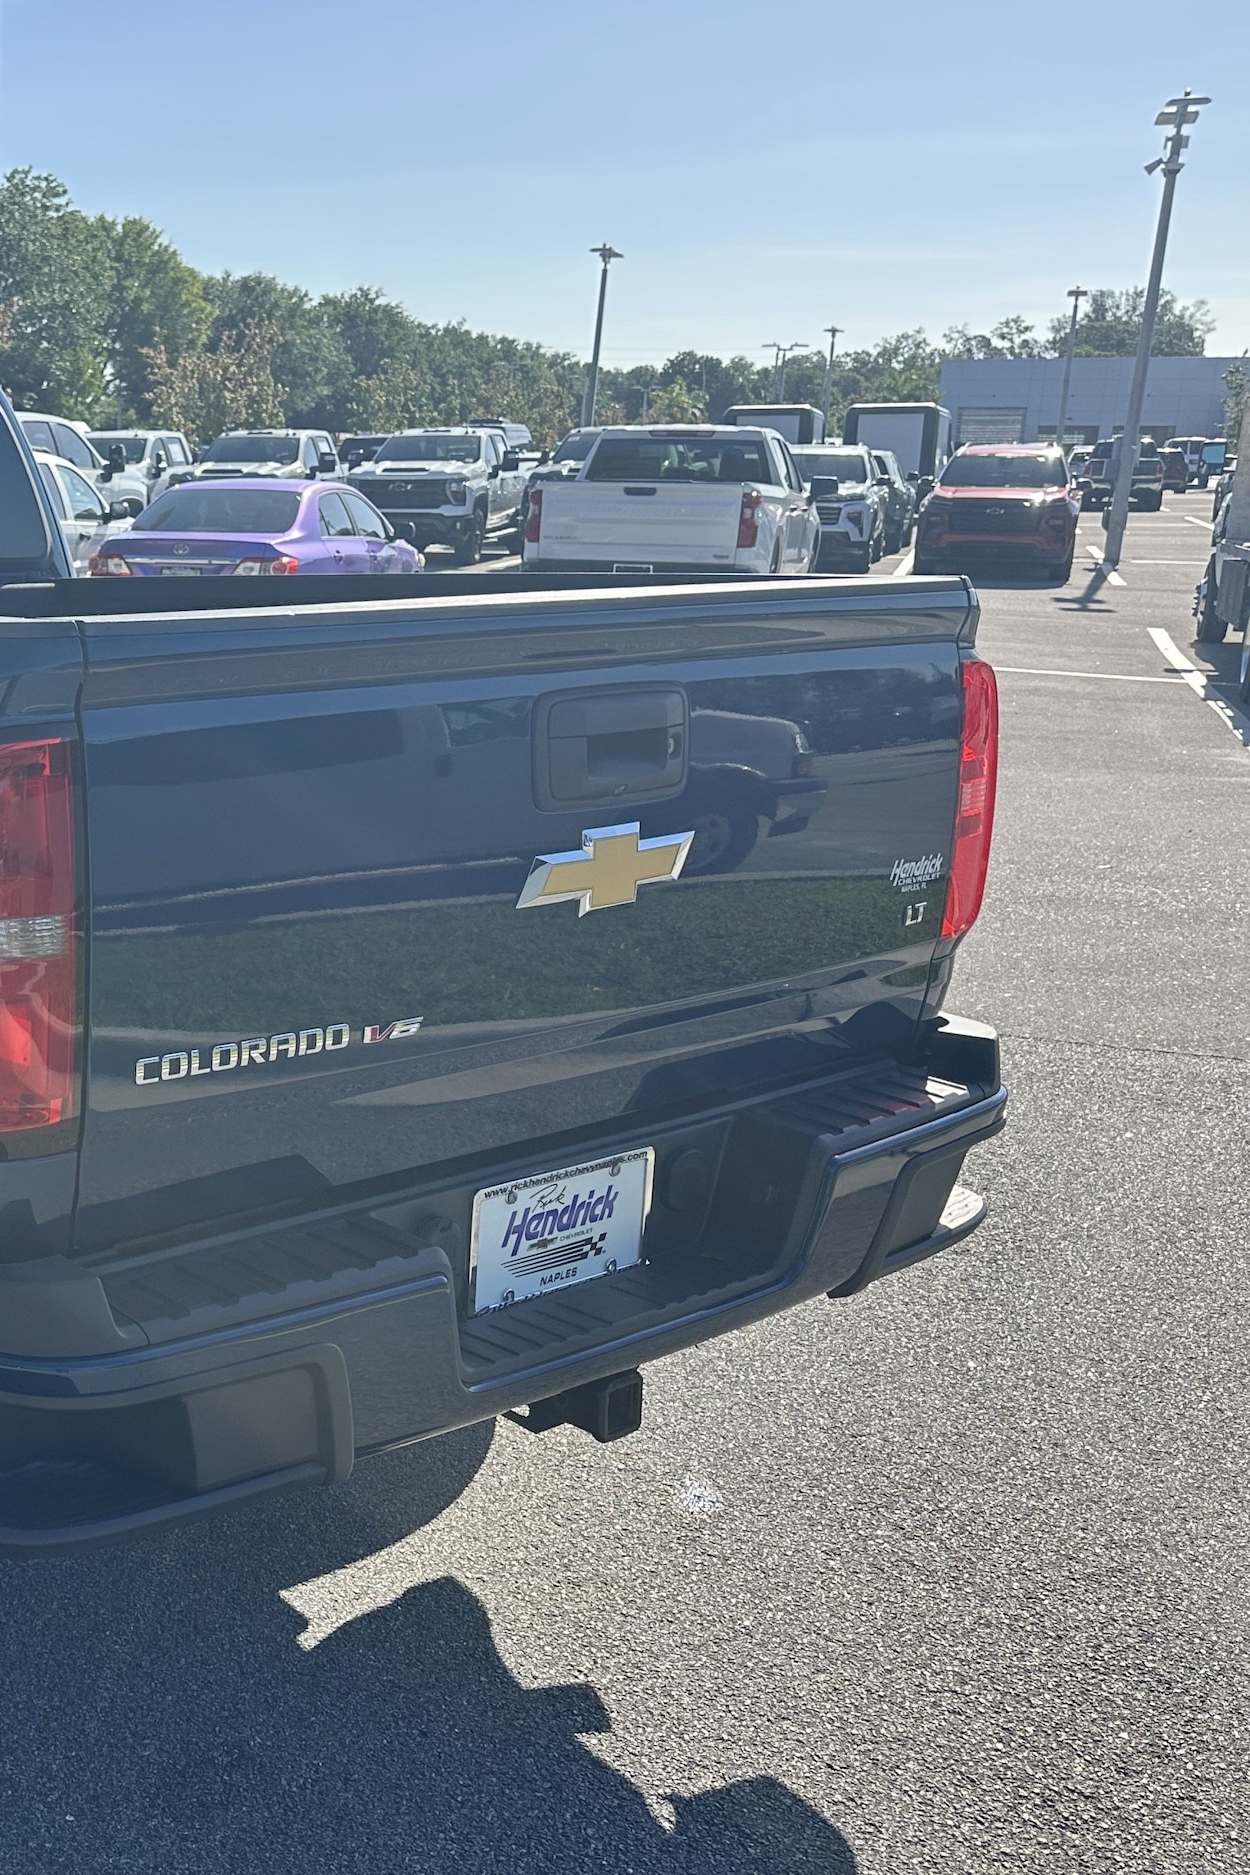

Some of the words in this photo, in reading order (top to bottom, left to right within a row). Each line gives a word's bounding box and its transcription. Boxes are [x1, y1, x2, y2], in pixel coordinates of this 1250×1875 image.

[890, 853, 943, 886] Hendrick
[898, 872, 941, 885] CHEVROLET
[905, 901, 927, 926] LT
[135, 1023, 350, 1085] COLORADO
[363, 1016, 424, 1044] V6
[501, 1184, 619, 1257] Hendrick
[559, 1227, 594, 1242] CHEVROLET
[540, 1266, 578, 1287] NAPLES
